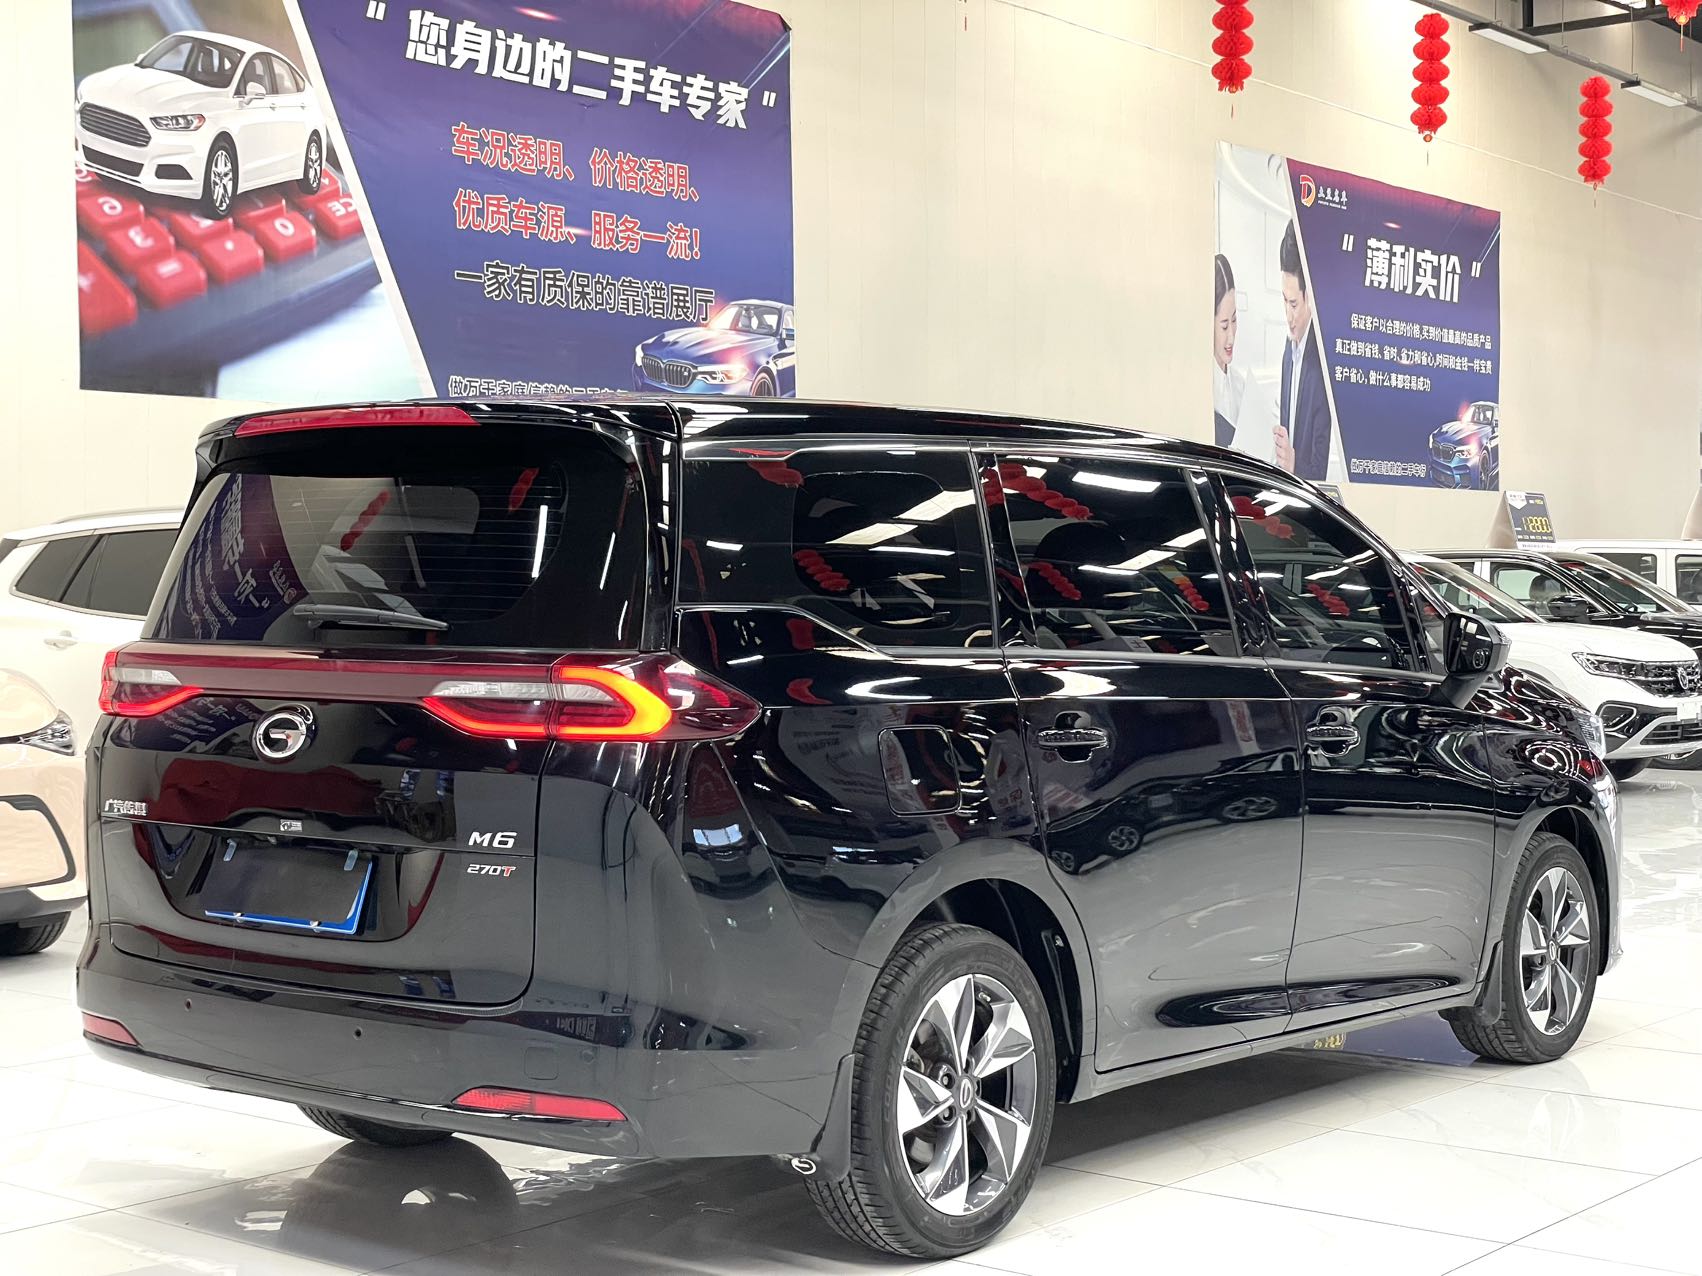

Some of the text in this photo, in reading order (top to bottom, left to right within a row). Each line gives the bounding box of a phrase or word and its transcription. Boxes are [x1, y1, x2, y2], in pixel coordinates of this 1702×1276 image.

[454, 260, 715, 324] 一家有质保的靠谱展厅
[468, 831, 518, 849] M6
[466, 863, 517, 877] 270T
